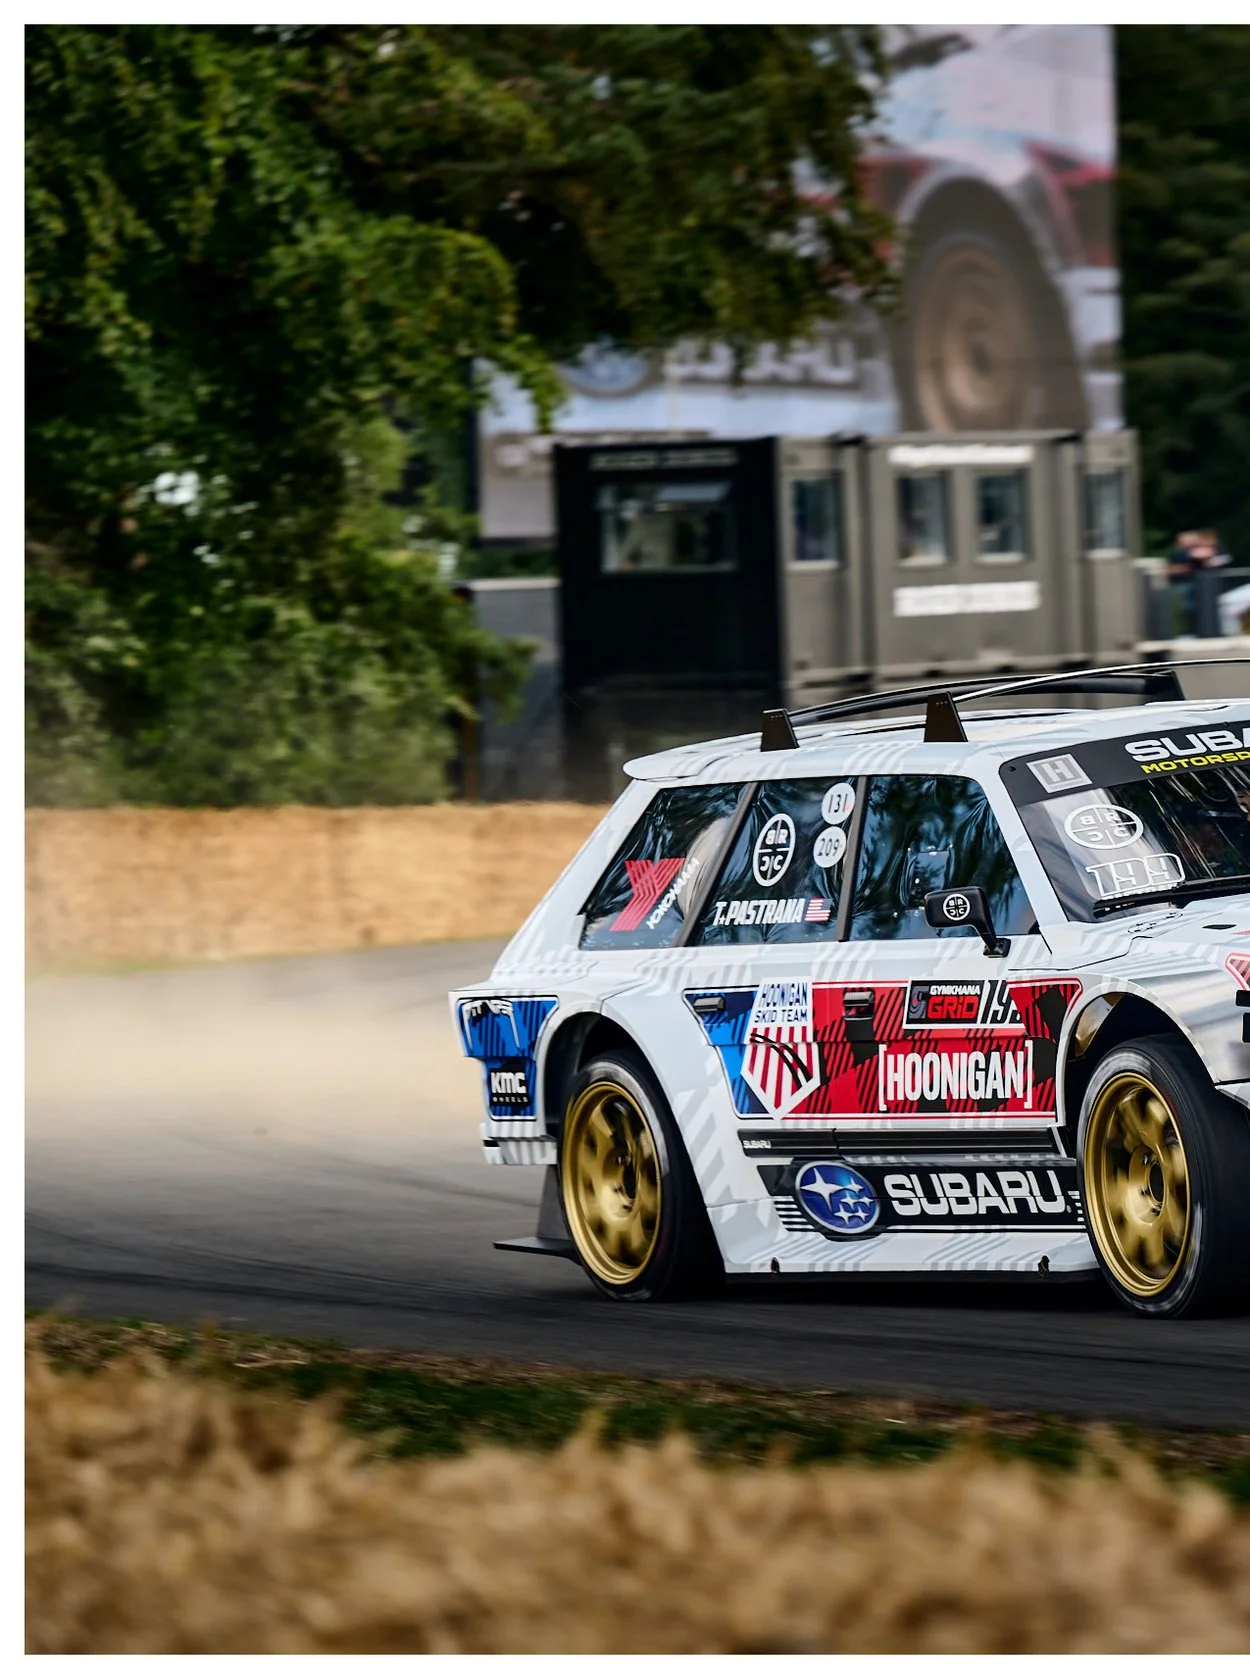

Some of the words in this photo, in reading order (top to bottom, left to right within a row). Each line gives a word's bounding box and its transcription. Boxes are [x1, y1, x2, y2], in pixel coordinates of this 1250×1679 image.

[825, 791, 850, 820] 131
[816, 837, 838, 857] 209
[646, 857, 700, 930] YOKOHAMA
[758, 982, 808, 1008] HOONIGAN
[929, 984, 981, 995] GYMKHANA
[755, 1009, 777, 1023] SKID
[781, 1008, 808, 1022] TEAM
[490, 1071, 527, 1093] KMC
[743, 1140, 771, 1149] SUBARU
[883, 1170, 1067, 1216] SUBARU
